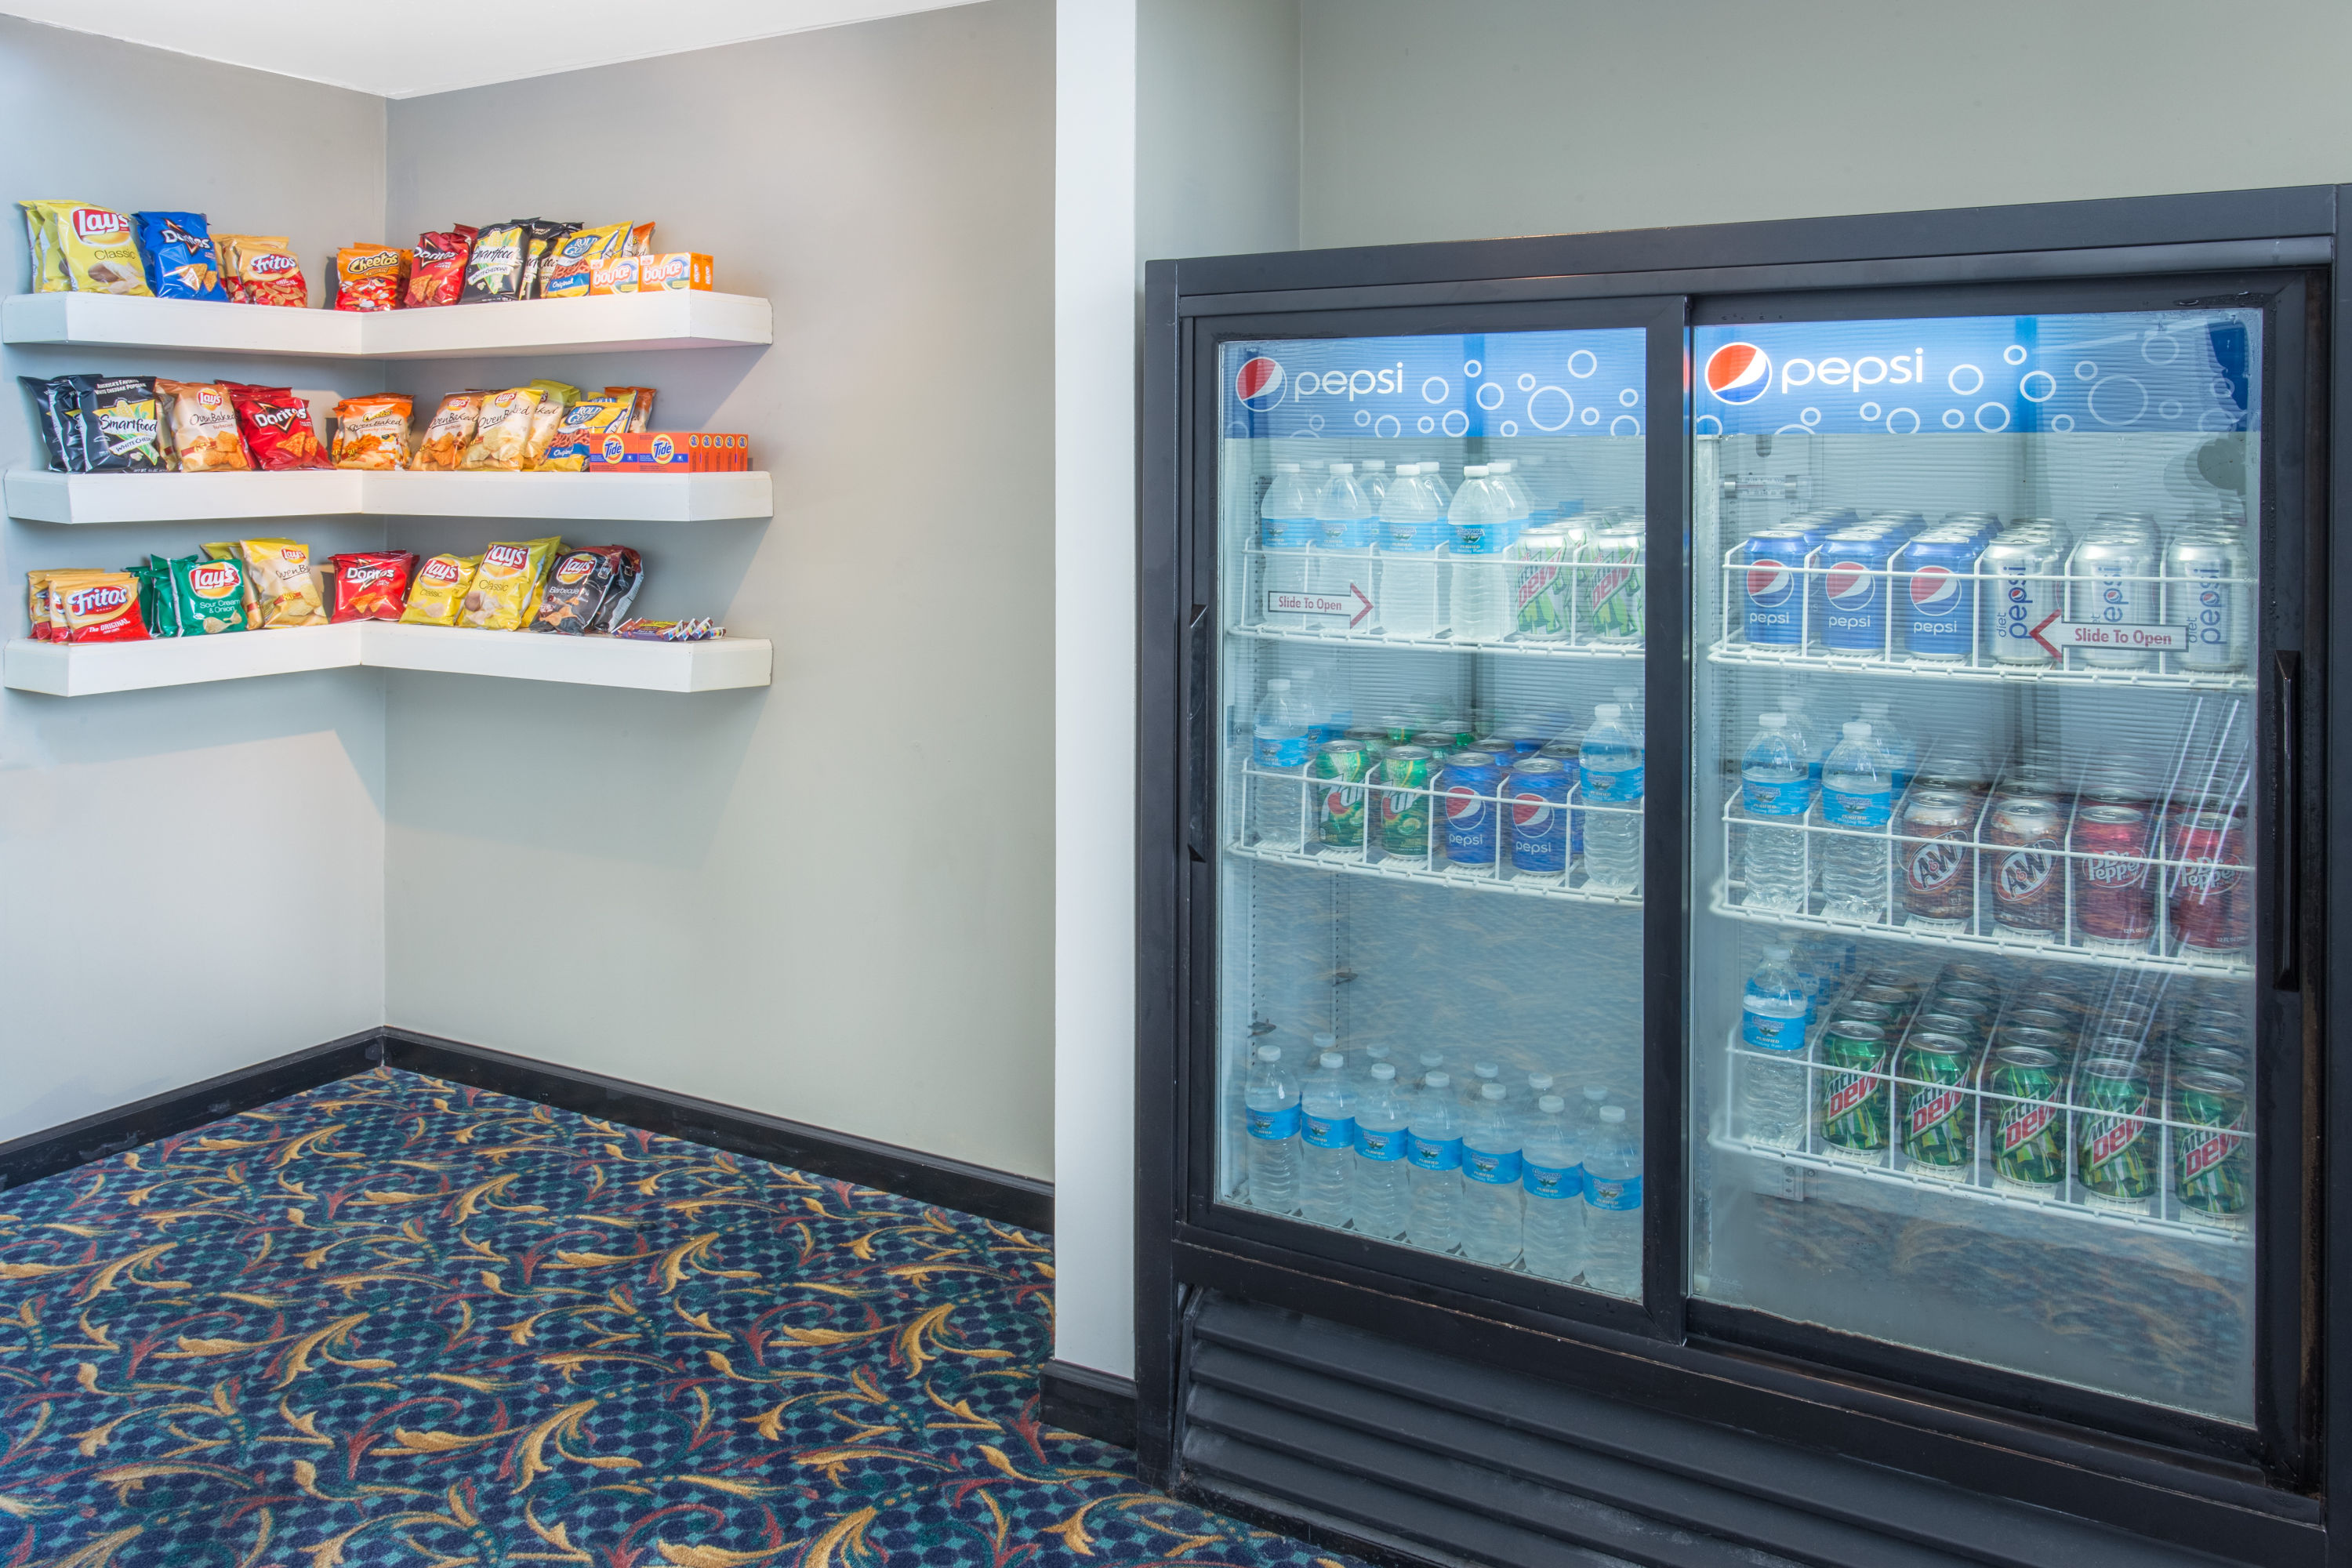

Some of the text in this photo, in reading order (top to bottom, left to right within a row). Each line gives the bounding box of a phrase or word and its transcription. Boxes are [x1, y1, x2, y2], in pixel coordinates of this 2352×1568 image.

[94, 249, 136, 260] Classic
[251, 254, 296, 274] Fritos
[349, 252, 398, 273] Cheetos
[593, 267, 631, 286] bounce
[644, 262, 683, 282] bounce
[1781, 347, 1924, 394] pepsi
[1294, 361, 1403, 402] pepsi
[100, 414, 157, 432] Smartfood
[255, 408, 307, 427] Doritos
[116, 441, 135, 452] WHITE
[604, 441, 622, 458] Tide
[654, 441, 672, 458] Tide
[483, 544, 527, 568] Lay's
[347, 567, 394, 579] Doritos
[422, 560, 457, 580] Lay's
[563, 558, 593, 575] Lay's
[479, 579, 509, 592] Classic
[2098, 566, 2129, 622] epsi
[67, 588, 128, 616] Fritos
[1278, 596, 1342, 612] Slide To Open
[2003, 566, 2033, 640] pepsi
[2194, 568, 2227, 644] pepsi
[100, 618, 130, 631] ORIGINAL
[1749, 612, 1790, 624] pepsi
[1828, 615, 1871, 630] pepsi
[1997, 612, 2007, 638] diet
[1913, 621, 1957, 636] pepsi
[2074, 628, 2172, 648] Slide To Open
[1450, 834, 1483, 847] pepsi
[1515, 842, 1551, 855] pepsi
[1918, 833, 1960, 888] A&W
[2007, 842, 2046, 898] A&W
[2088, 856, 2143, 884] Pepper
